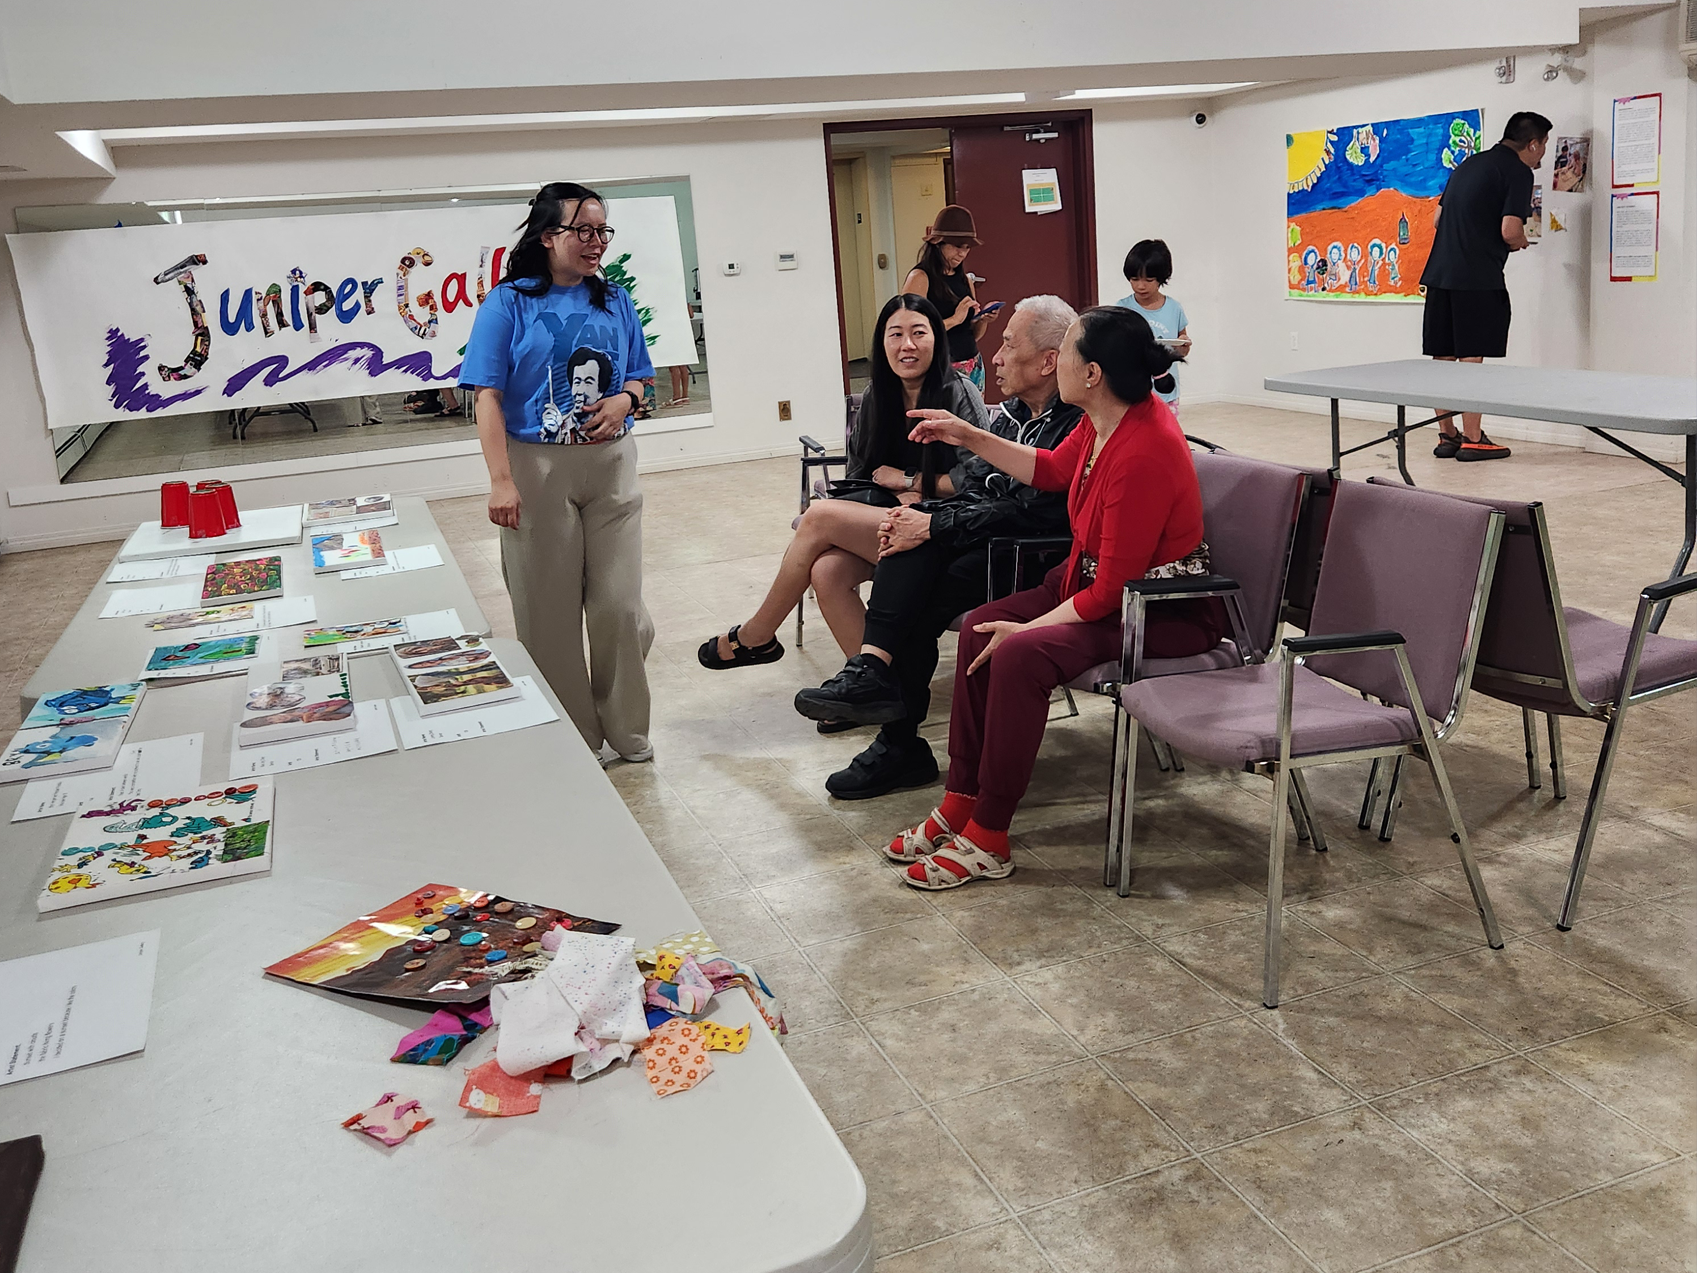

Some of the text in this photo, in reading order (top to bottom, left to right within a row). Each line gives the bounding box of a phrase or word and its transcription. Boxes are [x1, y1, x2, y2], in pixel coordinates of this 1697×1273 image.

[153, 246, 507, 382] Juniper Gall
[533, 311, 620, 362] YAN
